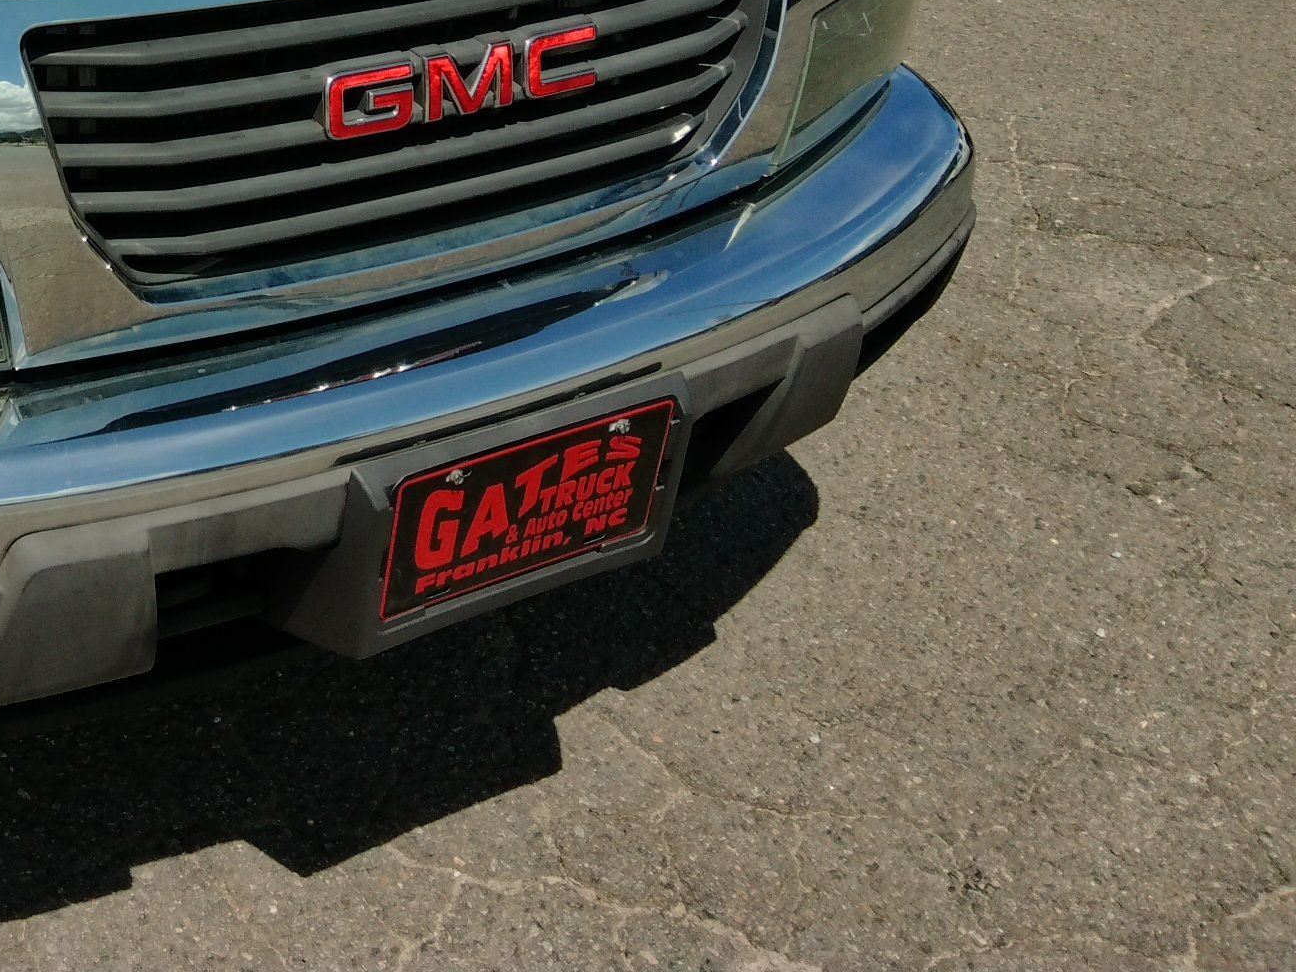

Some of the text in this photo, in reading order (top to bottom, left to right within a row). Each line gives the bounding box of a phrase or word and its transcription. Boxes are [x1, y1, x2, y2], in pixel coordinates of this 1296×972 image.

[324, 21, 598, 141] GMC
[414, 434, 643, 572] GATES
[505, 487, 634, 544] & Auto center
[539, 460, 636, 514] TRUCK
[414, 508, 628, 595] Franklin, NC
